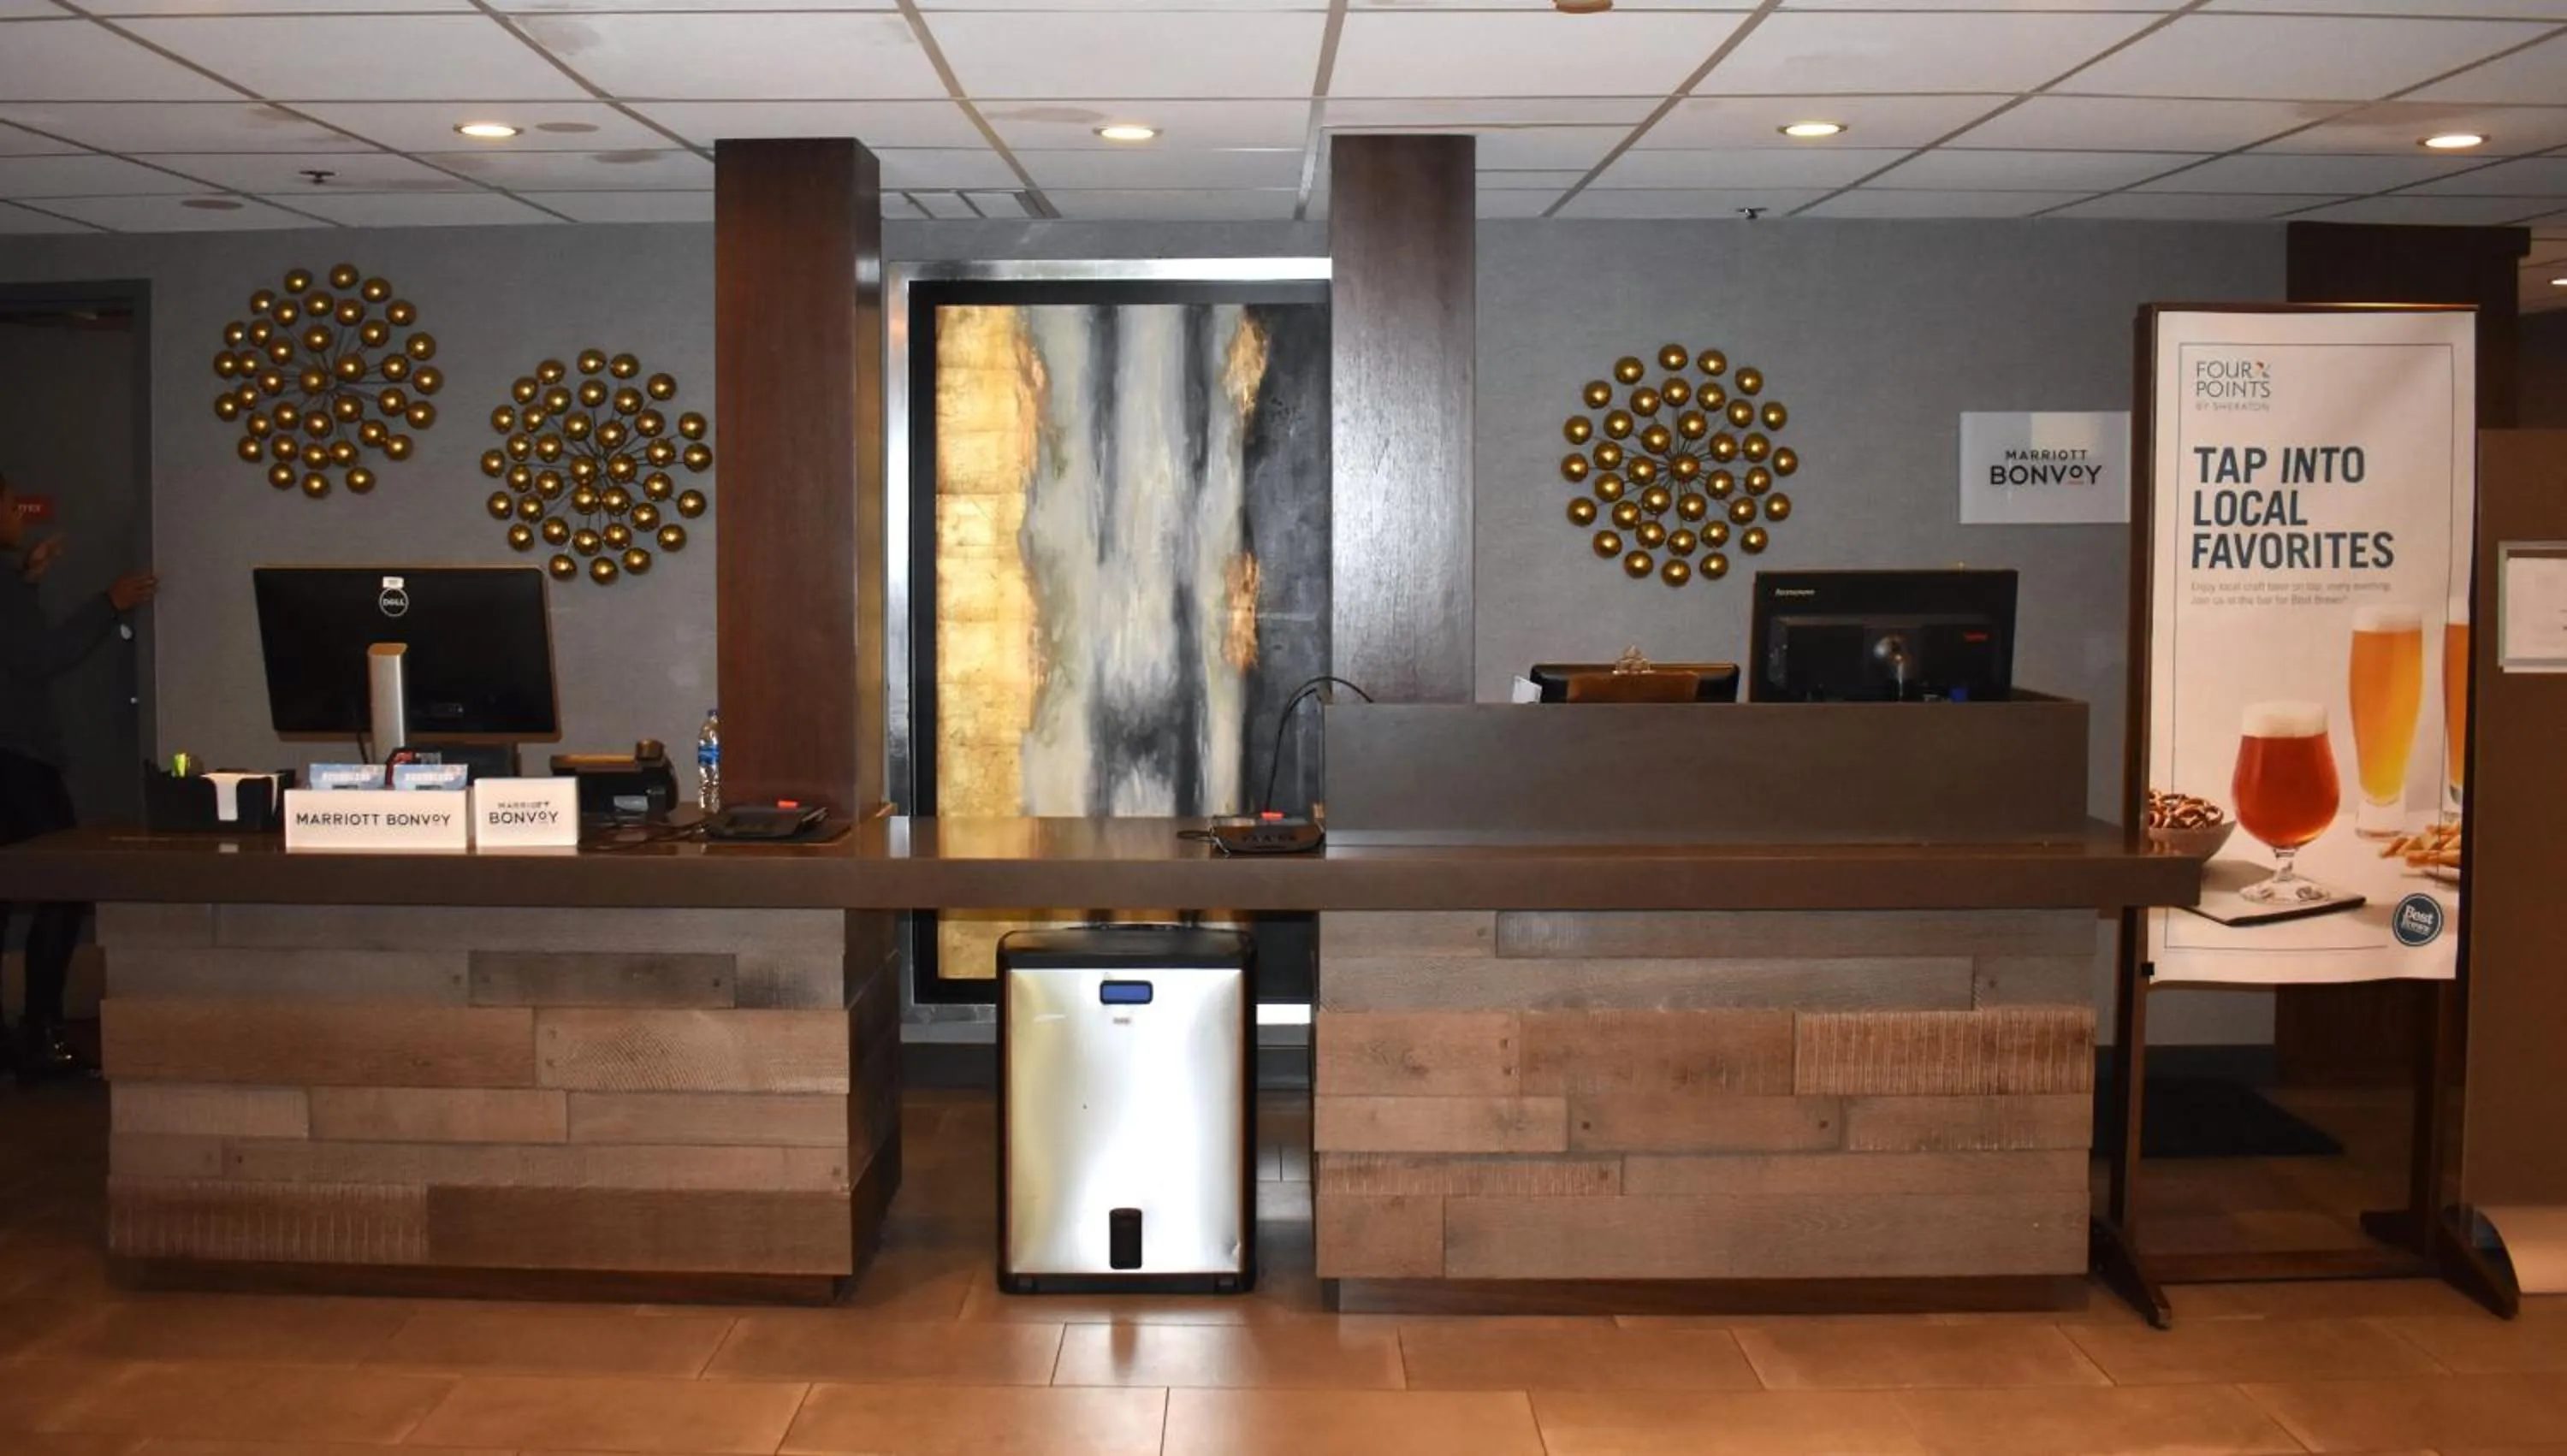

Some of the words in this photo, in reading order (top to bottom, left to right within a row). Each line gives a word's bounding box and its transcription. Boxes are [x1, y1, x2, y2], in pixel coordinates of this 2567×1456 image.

[2196, 359, 2252, 378] FOUR
[2196, 379, 2272, 399] POINTS
[2005, 449, 2089, 460] MARRIOTT
[2193, 446, 2268, 483] TAP
[2280, 446, 2365, 483] INTO
[1989, 465, 2102, 485] BONVOY
[2192, 489, 2308, 527] LOCAL
[2191, 530, 2395, 569] FAVORITES
[296, 813, 380, 826] MARRIOTT
[387, 813, 451, 826] BONVOY
[489, 811, 558, 824] BONVOY
